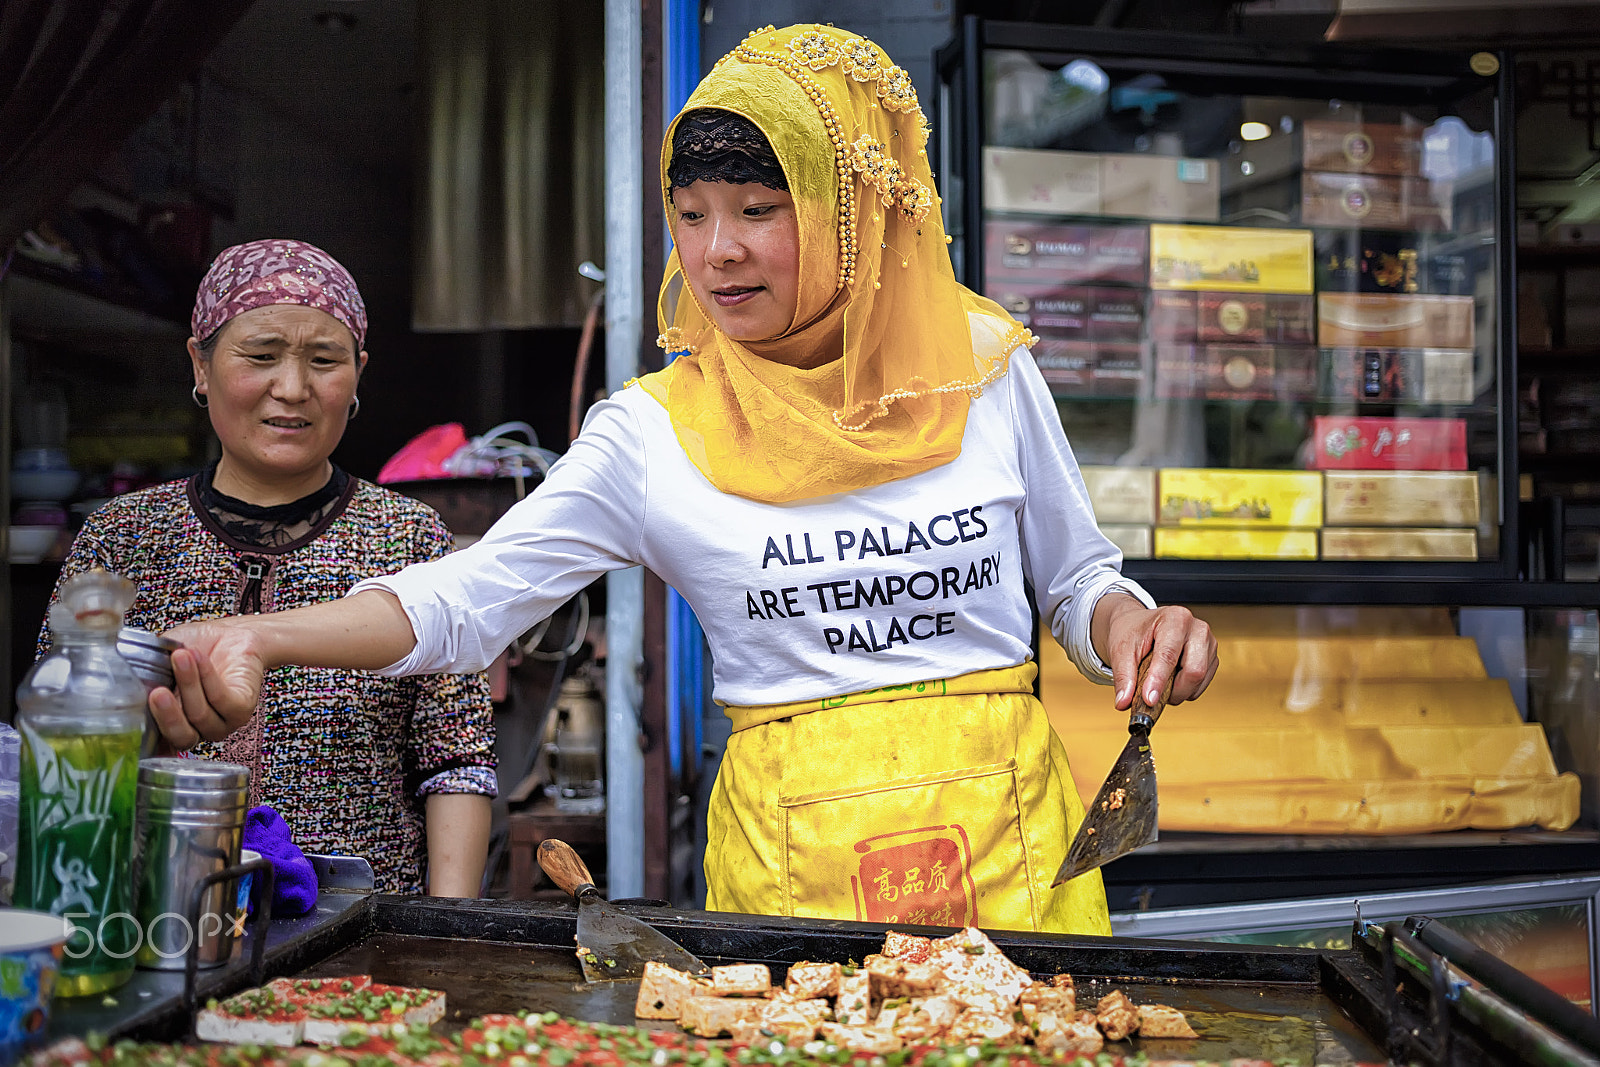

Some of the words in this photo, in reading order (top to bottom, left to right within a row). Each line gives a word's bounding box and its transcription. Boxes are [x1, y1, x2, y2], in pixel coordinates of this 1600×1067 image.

[762, 535, 825, 569] ALL
[835, 505, 988, 561] PALACES
[746, 587, 806, 620] ARE
[807, 551, 1001, 613] TEMPORARY
[823, 611, 956, 654] PALACE
[873, 860, 950, 902] 高品质
